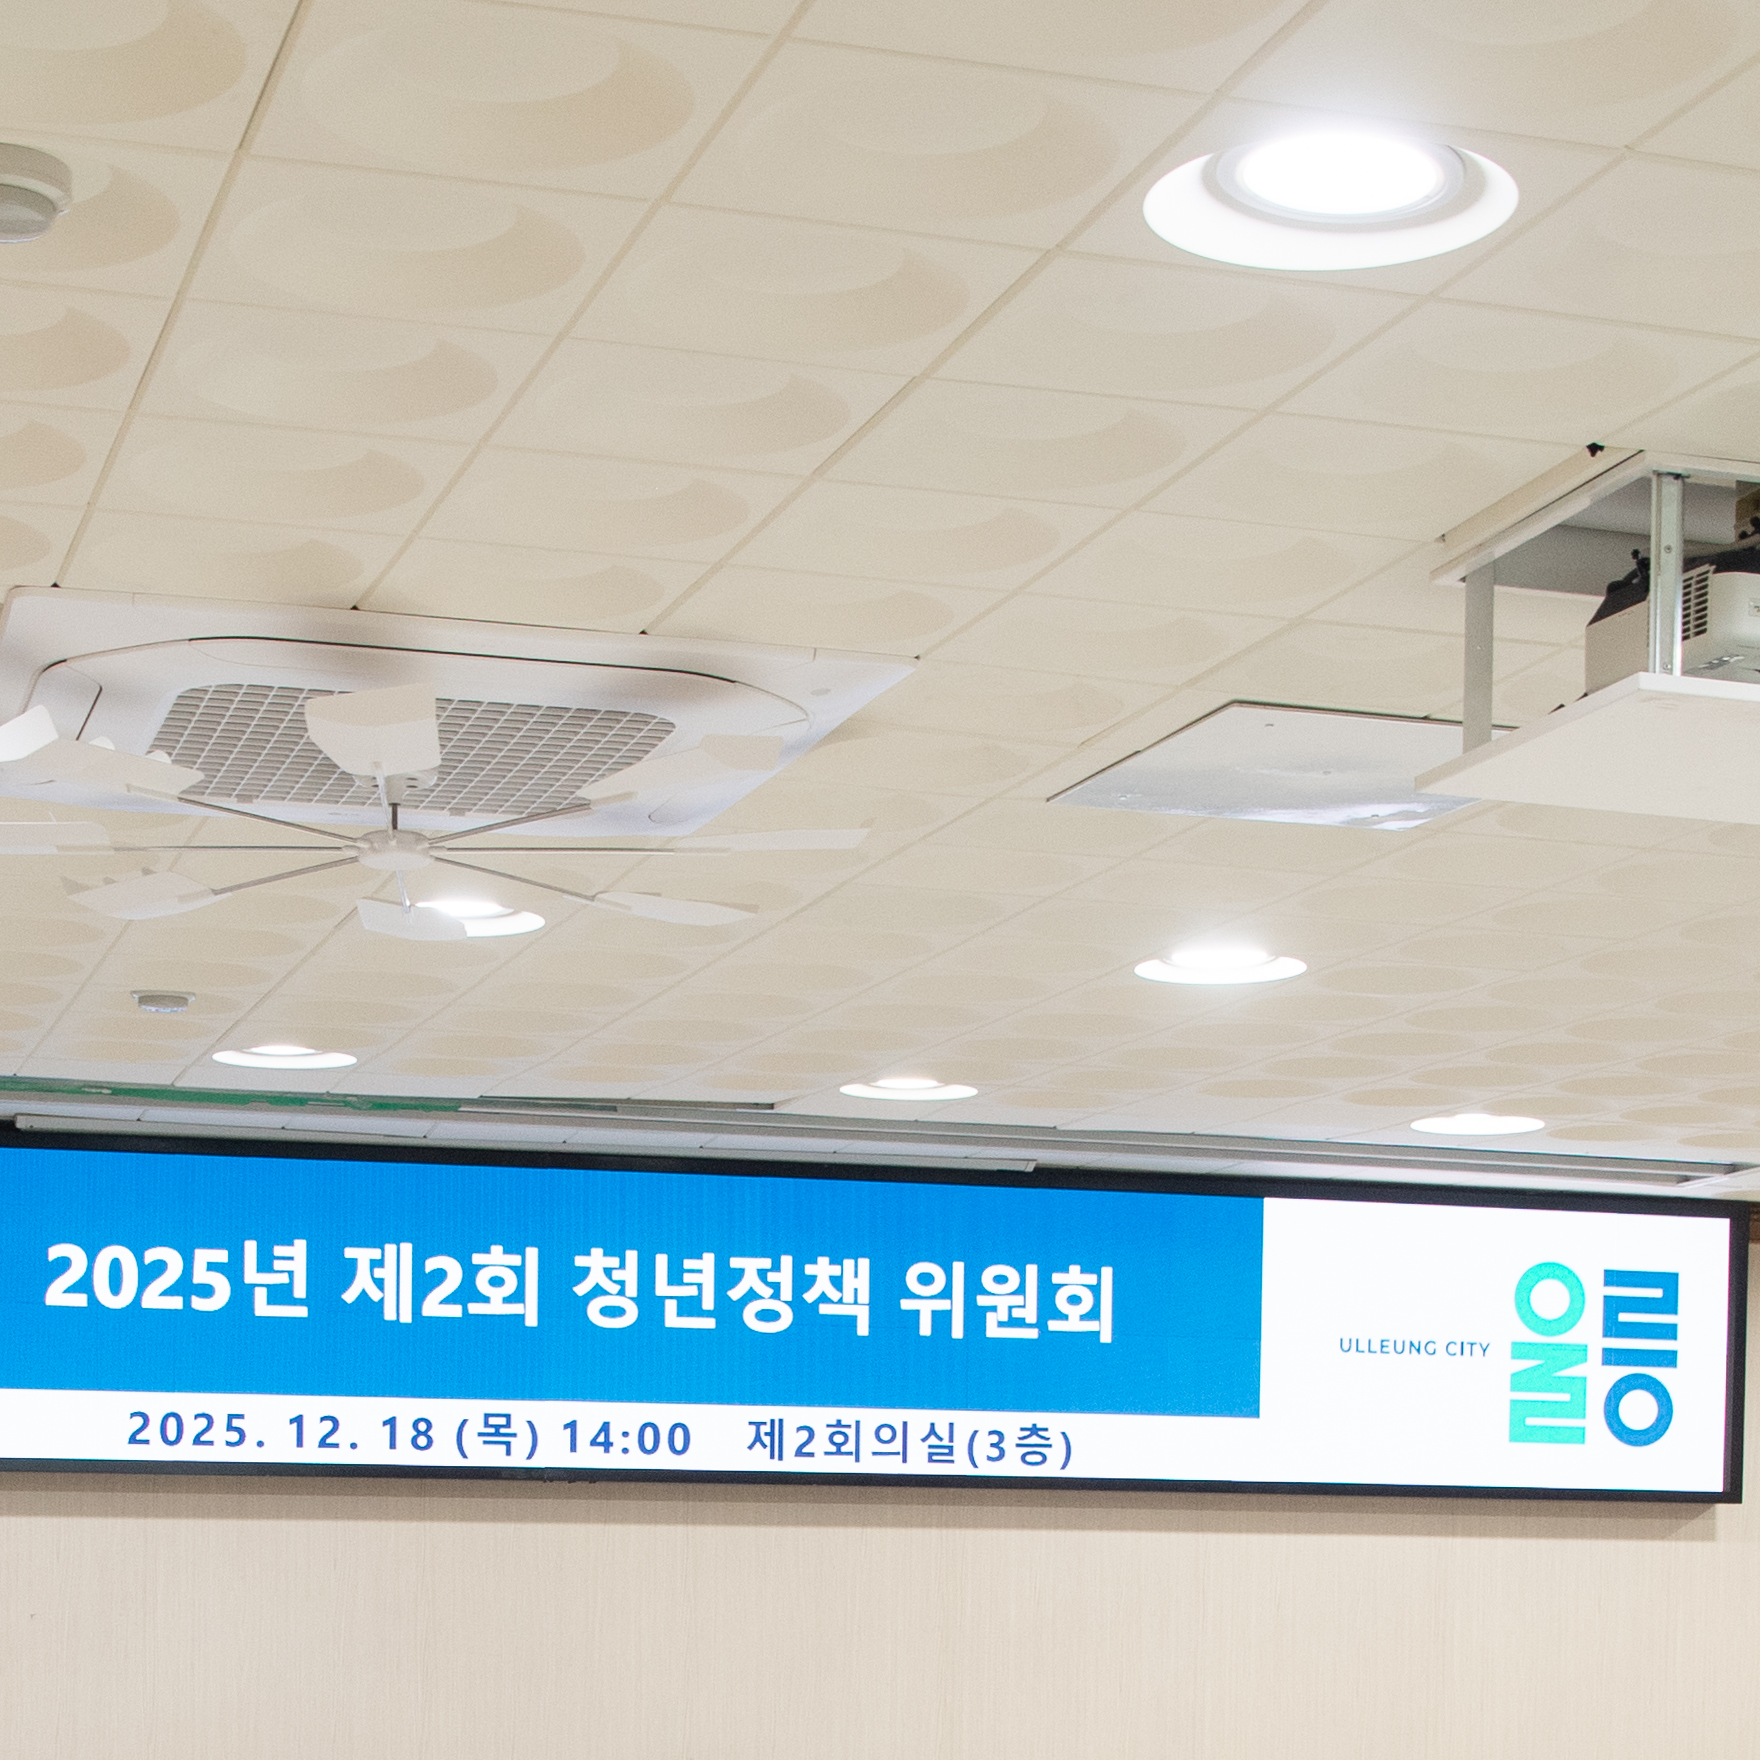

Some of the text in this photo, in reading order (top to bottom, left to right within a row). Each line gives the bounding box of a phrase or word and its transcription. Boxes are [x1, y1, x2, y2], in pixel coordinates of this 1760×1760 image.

[44, 1239, 1114, 1344] 2025년 제2회 청년정책 위원회
[1339, 1337, 1491, 1357] ULLEUNG CITY
[127, 1411, 1073, 1470] 2025. 12. 18 (목) 14:00 제2회의실(3층)
